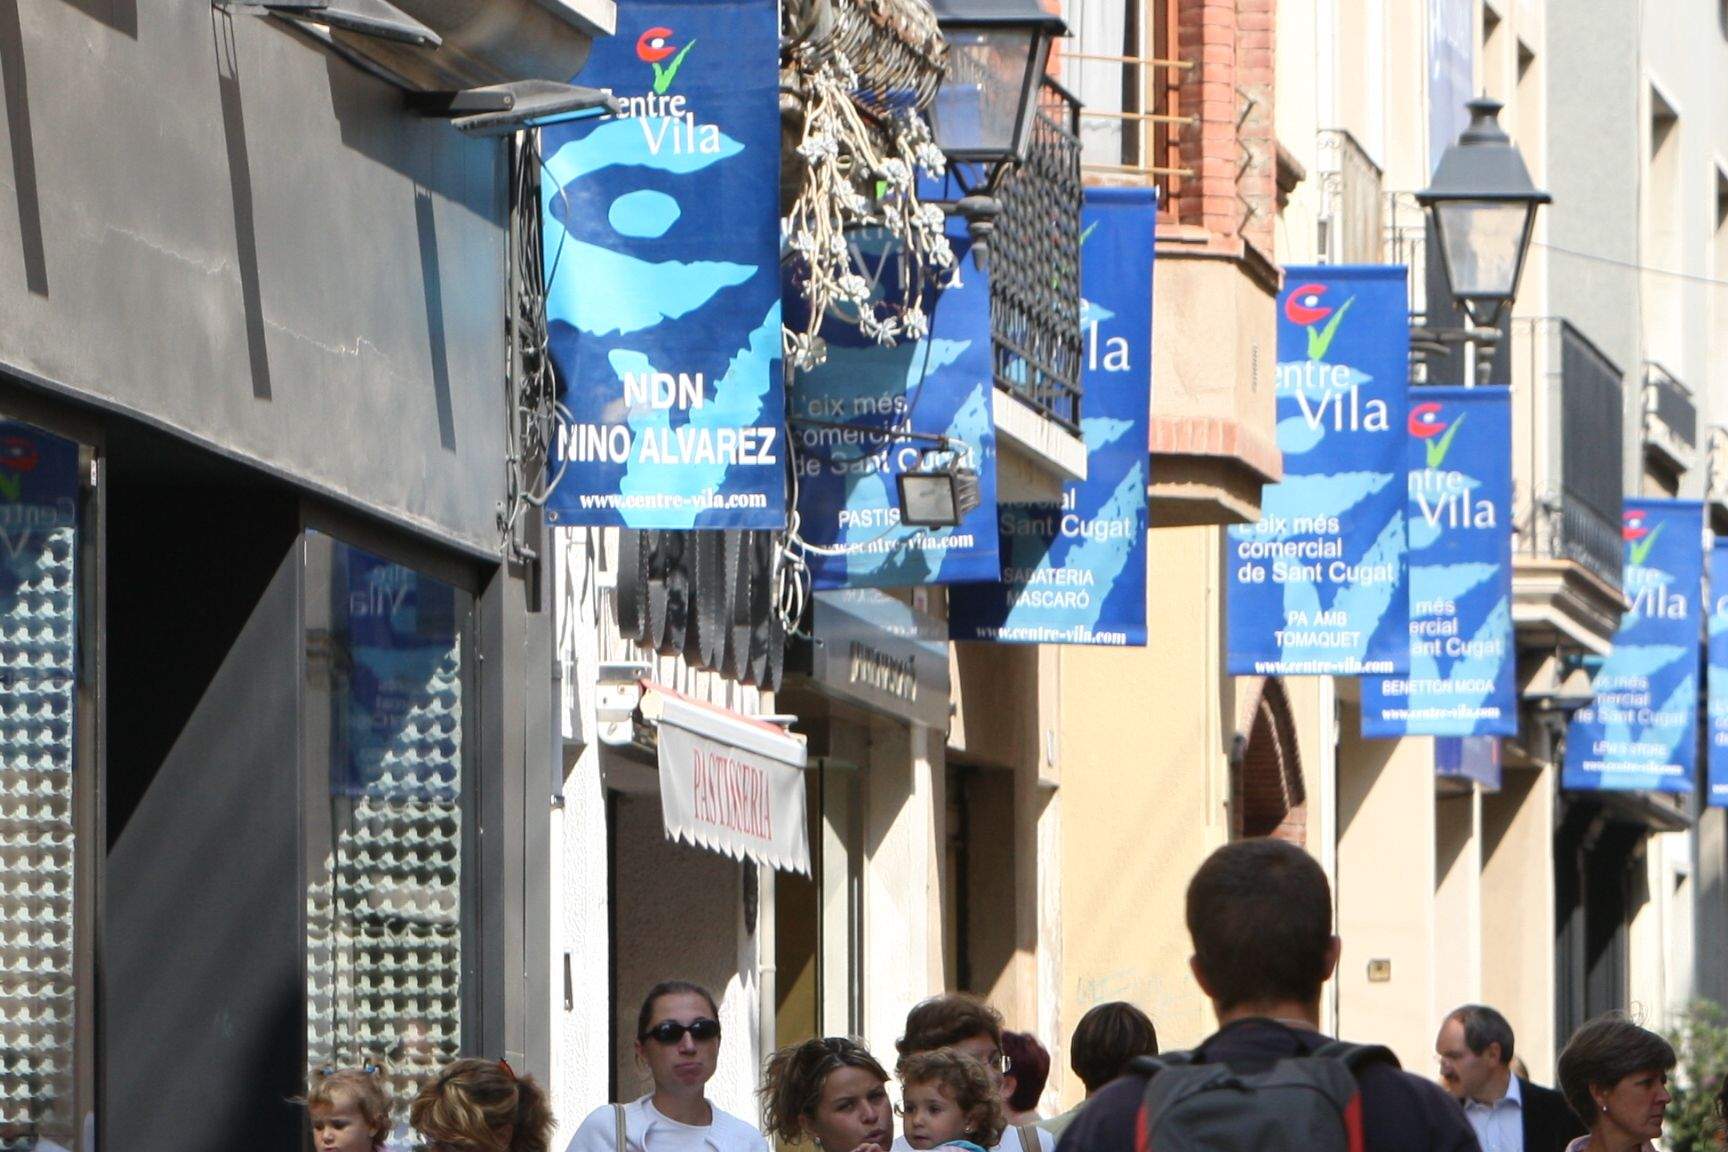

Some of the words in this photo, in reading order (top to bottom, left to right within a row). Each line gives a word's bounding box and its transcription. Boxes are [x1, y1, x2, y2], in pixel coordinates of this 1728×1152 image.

[640, 112, 721, 155] Vila
[1086, 319, 1131, 372] la
[1276, 360, 1350, 389] entre
[622, 373, 704, 410] NDN
[853, 389, 908, 416] més
[1295, 384, 1389, 432] Vila
[558, 424, 631, 464] NINO
[638, 427, 776, 464] ALVAREZ
[830, 449, 890, 475] Sant
[1408, 468, 1464, 494] ntre
[580, 487, 767, 509] www.centre-vila.com
[1416, 487, 1497, 529] Vila
[838, 507, 901, 528] PASTIS
[1001, 513, 1053, 536] Sant
[1061, 513, 1132, 543] Cugat
[1293, 511, 1340, 534] més
[1238, 537, 1343, 559] comercial
[1004, 567, 1095, 586] SABATERIA
[1238, 562, 1265, 584] de
[1272, 560, 1323, 584] Sant
[1328, 560, 1394, 587] Cugat
[1006, 588, 1090, 609] MASCARÓ
[1288, 610, 1308, 628] PA
[1314, 610, 1349, 628] AMB
[1409, 617, 1458, 638] ercial
[976, 624, 1126, 645] www.centre-vila.com
[1274, 630, 1361, 649] TOMAQUET
[1411, 638, 1441, 658] ant
[1254, 656, 1394, 674] www.centre-vila.com
[692, 748, 773, 841] PASTISSERIA
